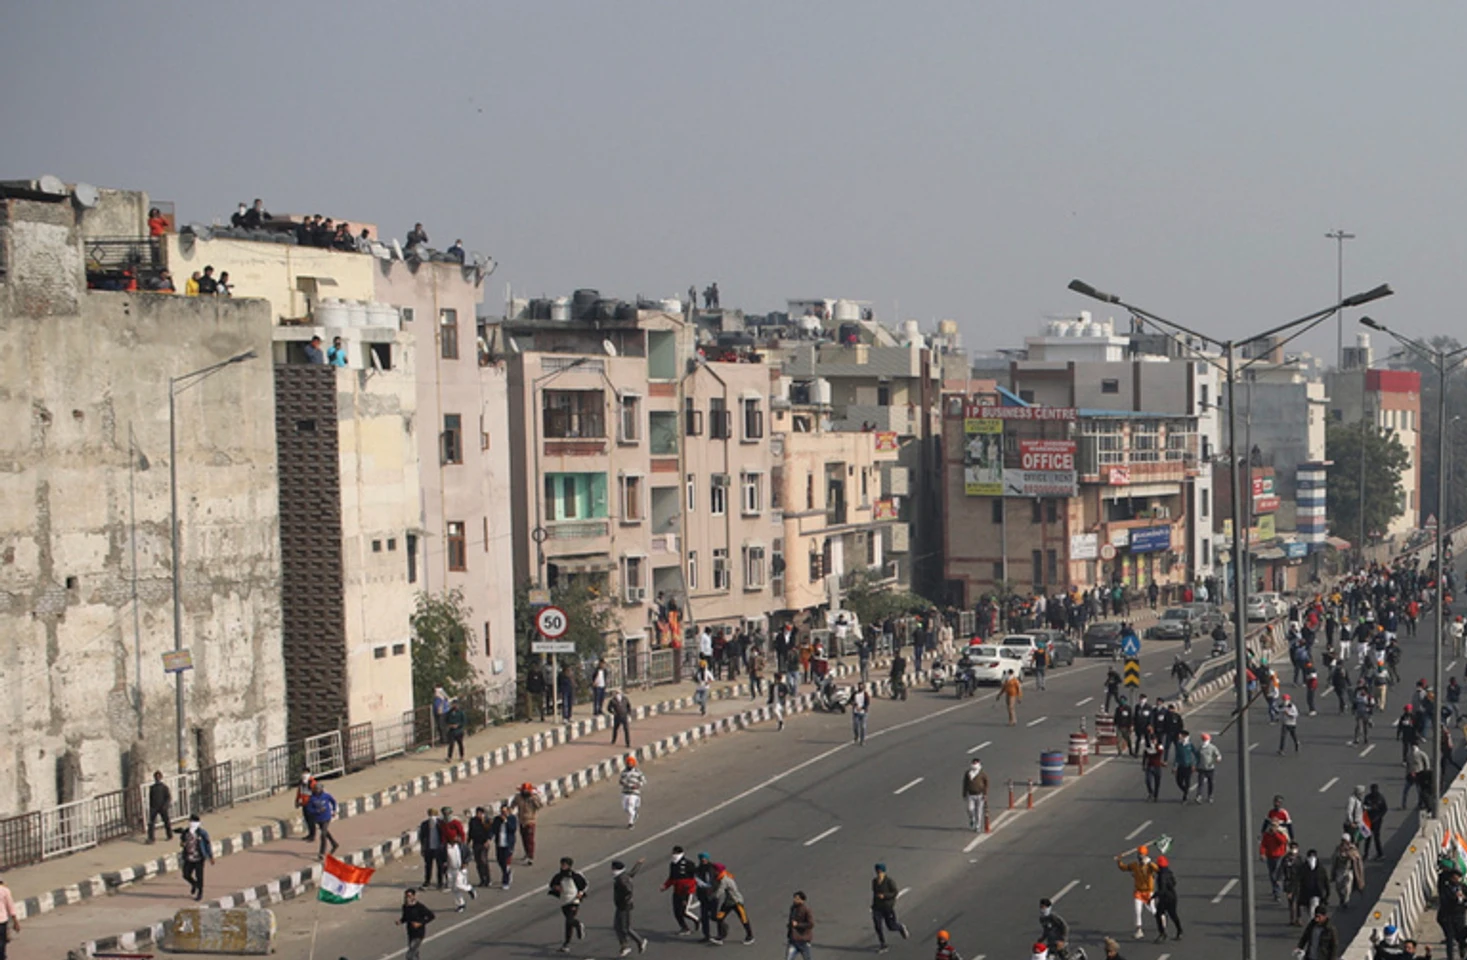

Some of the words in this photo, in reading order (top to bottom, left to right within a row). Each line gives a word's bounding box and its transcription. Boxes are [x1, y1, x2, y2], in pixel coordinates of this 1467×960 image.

[973, 407, 979, 418] P
[982, 407, 1032, 420] BUSINESS
[1034, 408, 1076, 420] CENTRE
[1023, 453, 1071, 469] OFFICE
[544, 616, 562, 629] 50
